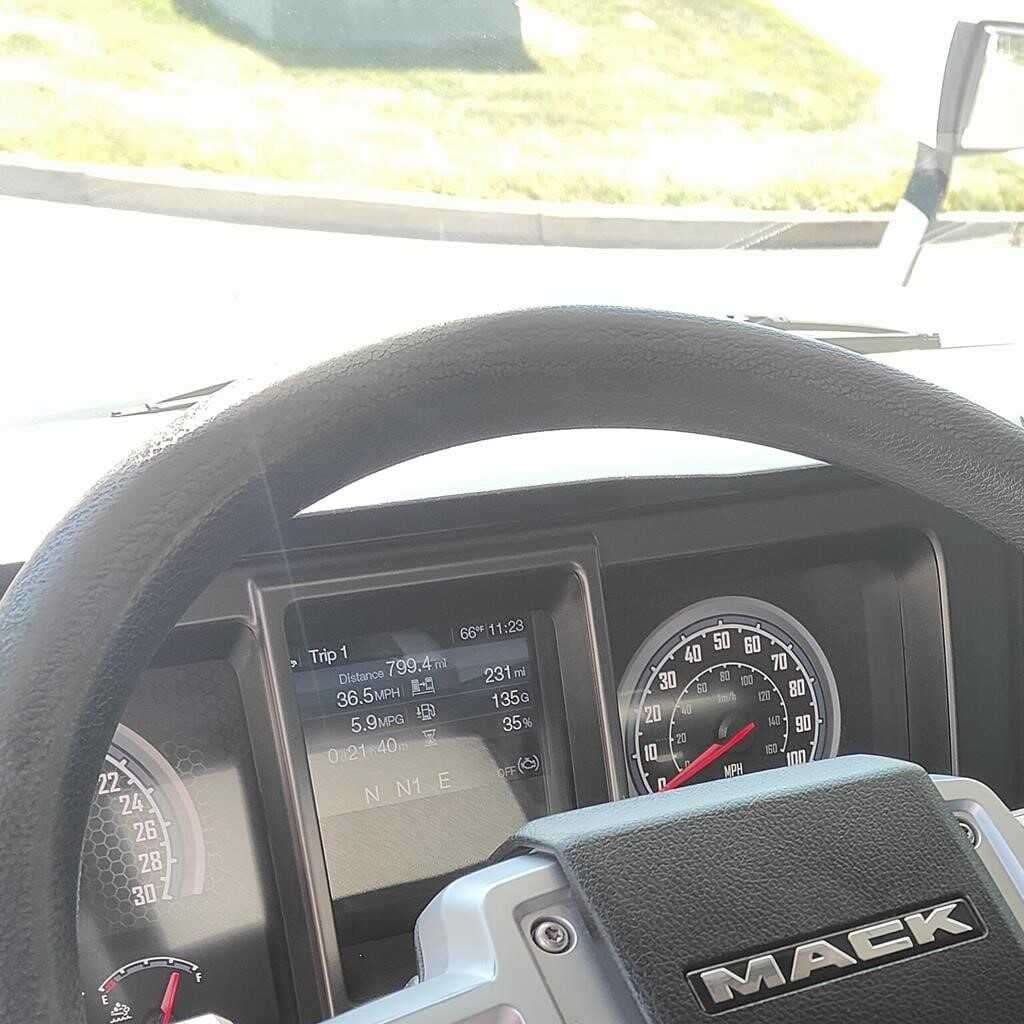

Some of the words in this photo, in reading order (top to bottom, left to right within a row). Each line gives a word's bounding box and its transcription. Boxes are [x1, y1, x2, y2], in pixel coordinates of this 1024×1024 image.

[488, 619, 525, 636] 11:23
[713, 631, 731, 651] 50
[743, 635, 761, 654] 60
[308, 648, 337, 665] Trip
[340, 645, 348, 659] 1
[684, 644, 702, 664] 40
[771, 653, 788, 672] 70
[338, 670, 385, 685] Distance
[385, 655, 433, 677] 799.4
[483, 664, 512, 684] 231
[719, 671, 730, 682] 80
[658, 670, 677, 691] 30
[696, 682, 708, 694] 60
[740, 674, 754, 687] 100
[788, 678, 805, 697] 80
[757, 689, 771, 702] 120
[644, 704, 662, 723] 20
[681, 704, 692, 715] 40
[768, 715, 781, 727] 140
[795, 714, 812, 733] 90
[676, 732, 687, 745] 20
[644, 743, 658, 762] 10
[765, 743, 778, 755] 160
[786, 749, 806, 766] 100
[723, 762, 743, 778] MPH
[98, 771, 121, 795] 22
[119, 793, 144, 816] 24
[133, 819, 159, 843] 26
[138, 850, 163, 874] 28
[131, 883, 157, 907] 30
[700, 903, 974, 1003] MACK
